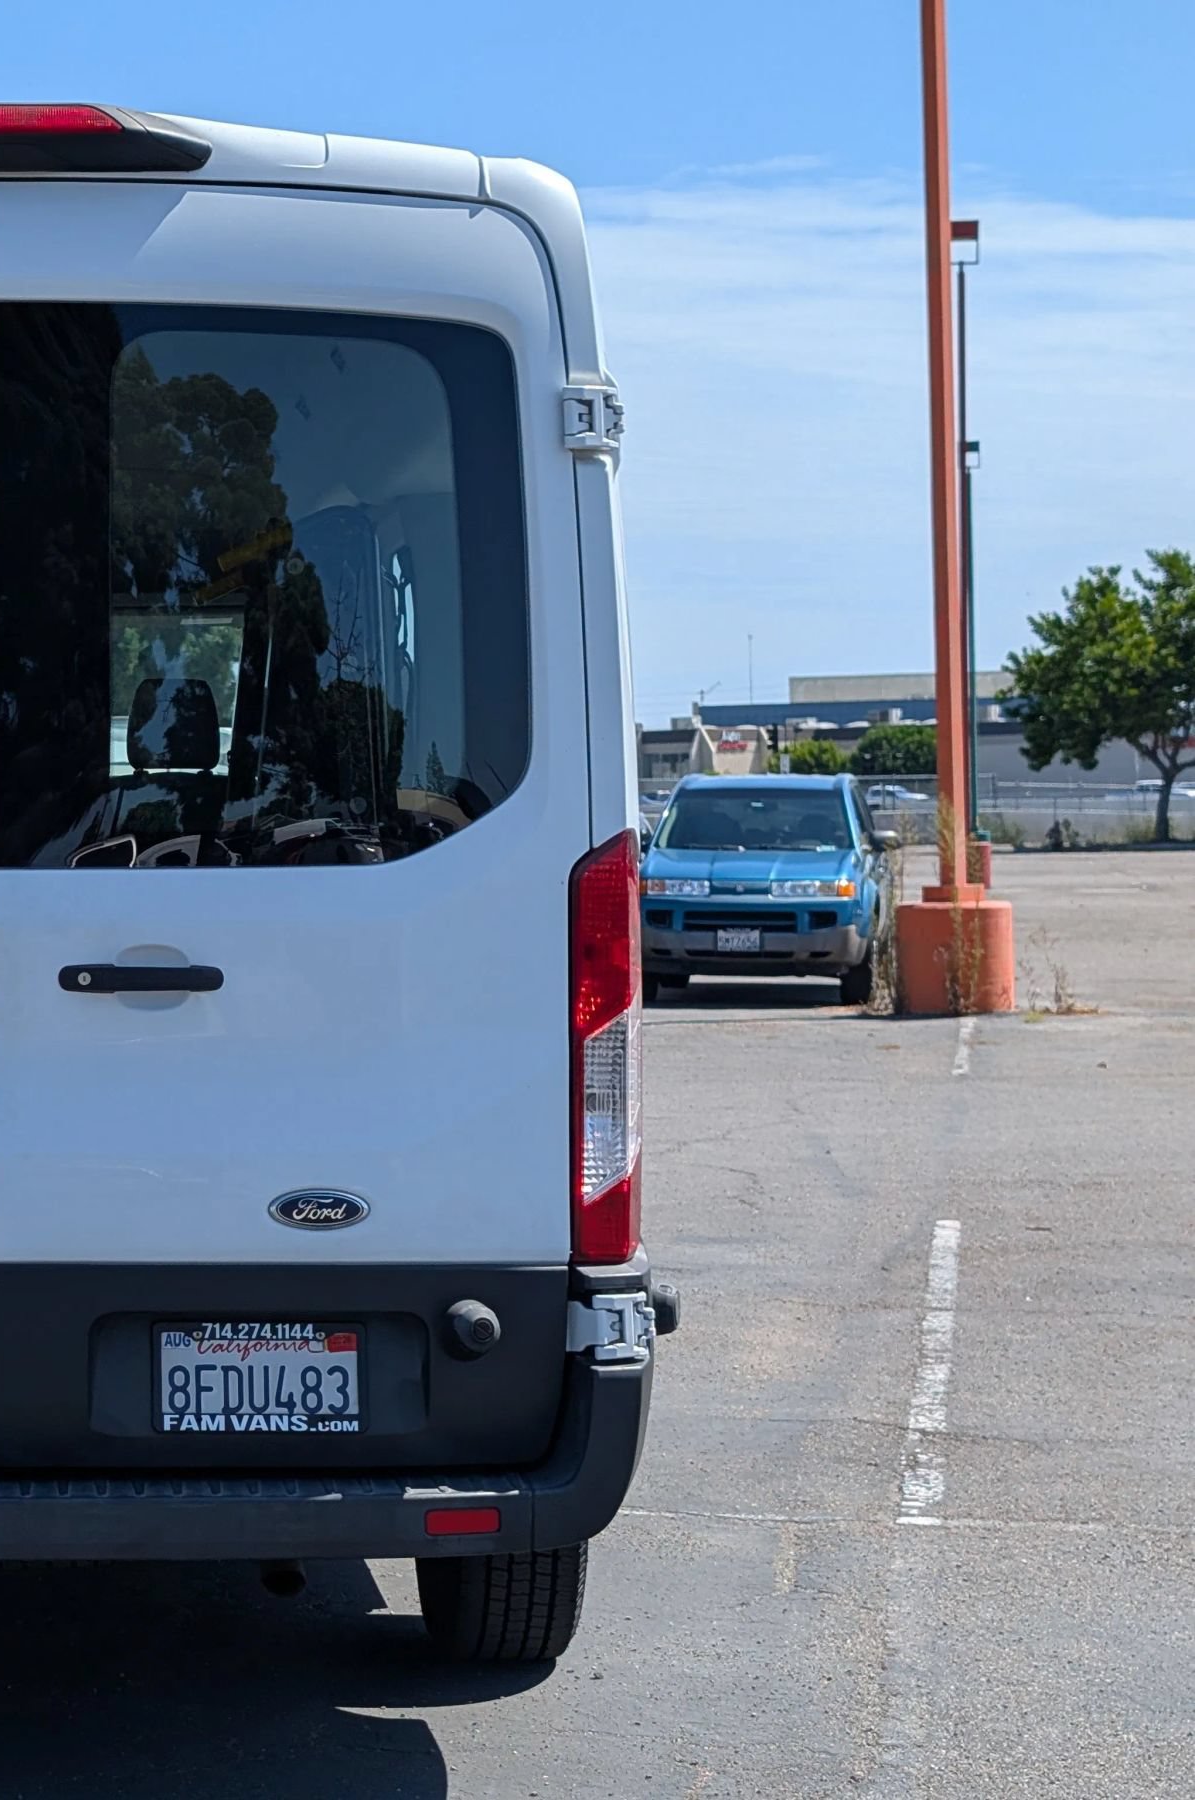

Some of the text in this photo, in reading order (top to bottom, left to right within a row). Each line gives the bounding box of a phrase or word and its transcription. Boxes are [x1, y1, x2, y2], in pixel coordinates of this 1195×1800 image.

[292, 1197, 347, 1220] Ford
[164, 1333, 192, 1348] AUG
[202, 1323, 314, 1339] 714.274.1144
[197, 1338, 312, 1361] California
[168, 1364, 350, 1414] 8FDU483
